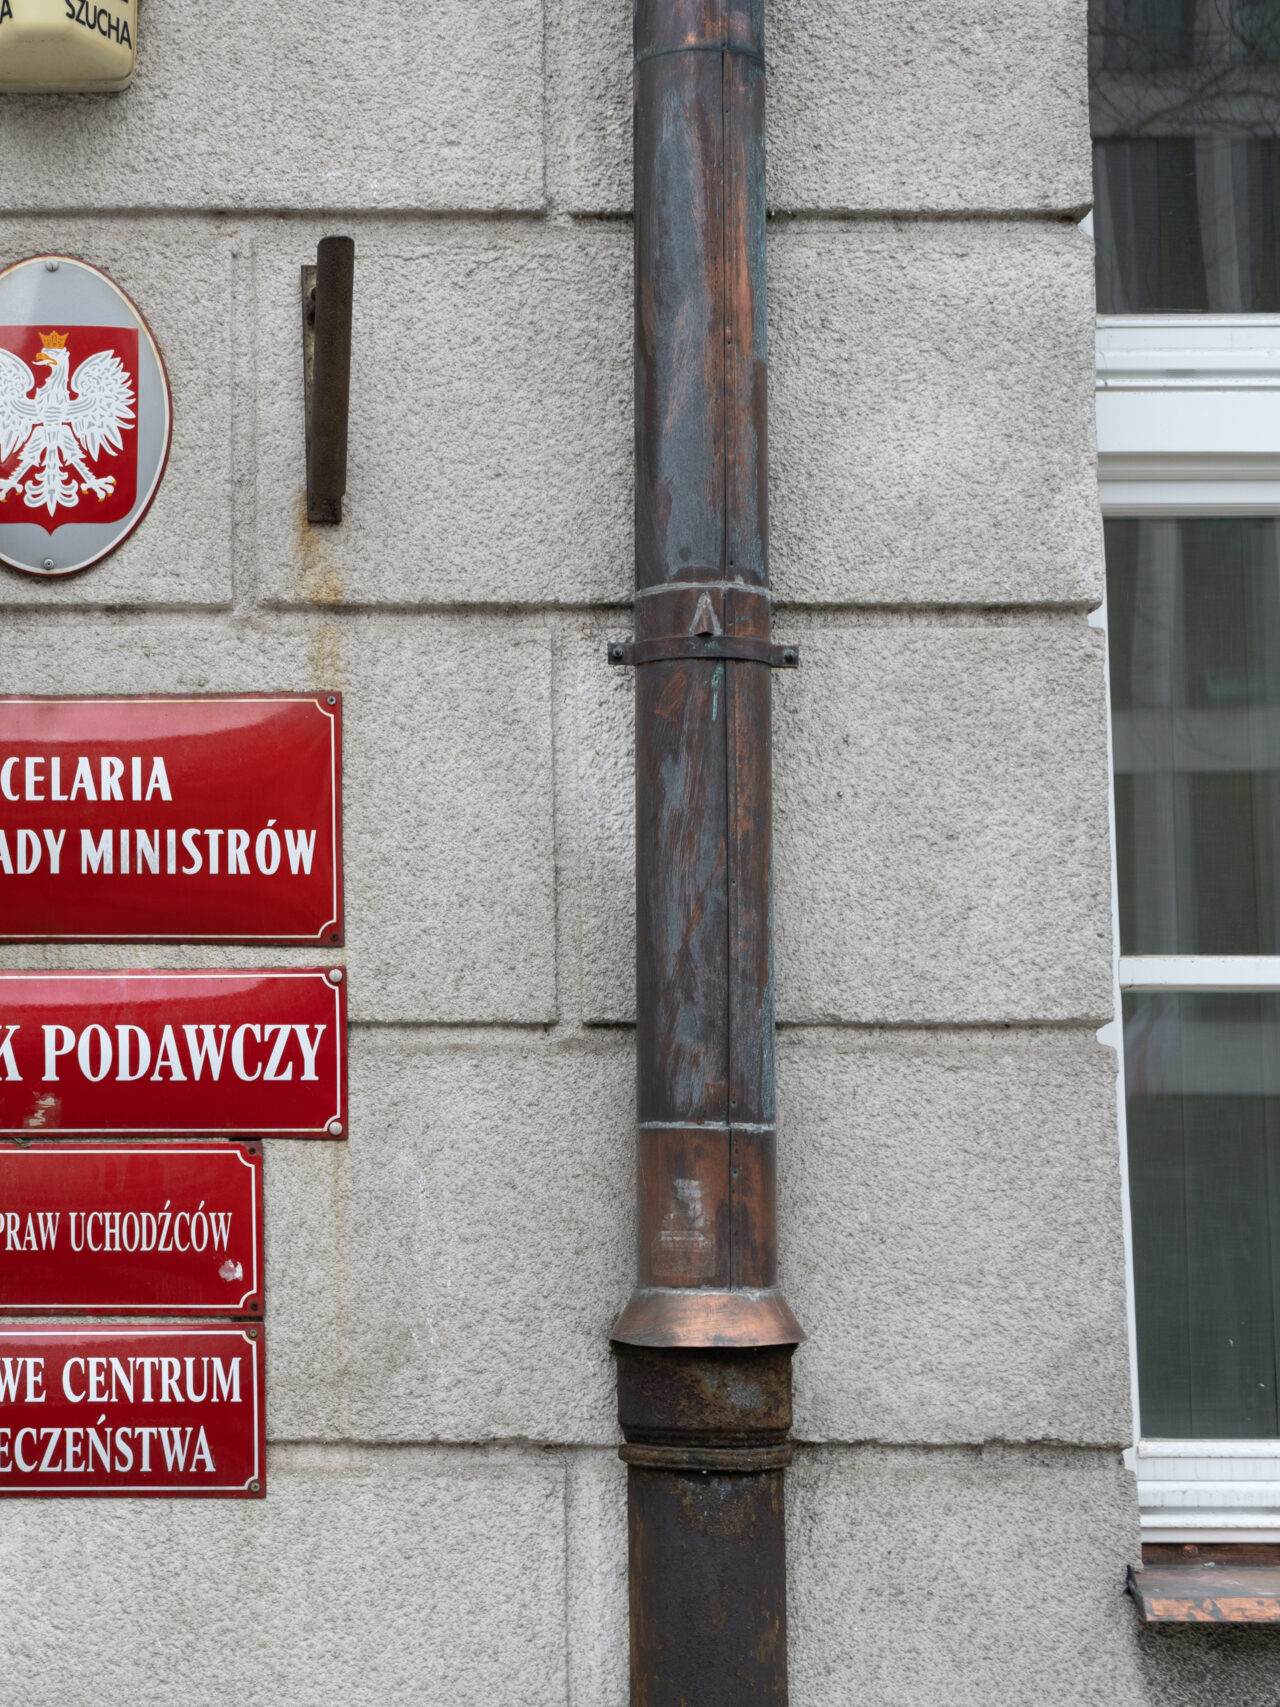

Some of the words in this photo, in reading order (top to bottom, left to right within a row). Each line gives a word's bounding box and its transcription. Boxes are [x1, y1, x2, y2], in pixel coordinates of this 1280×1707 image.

[65, 0, 132, 50] SZUCHA
[79, 819, 317, 876] MINISTRÓW
[41, 1023, 327, 1083] PODAWCZY
[68, 1199, 233, 1252] UCHODŹCÓW
[62, 1356, 243, 1404] CENTRUM
